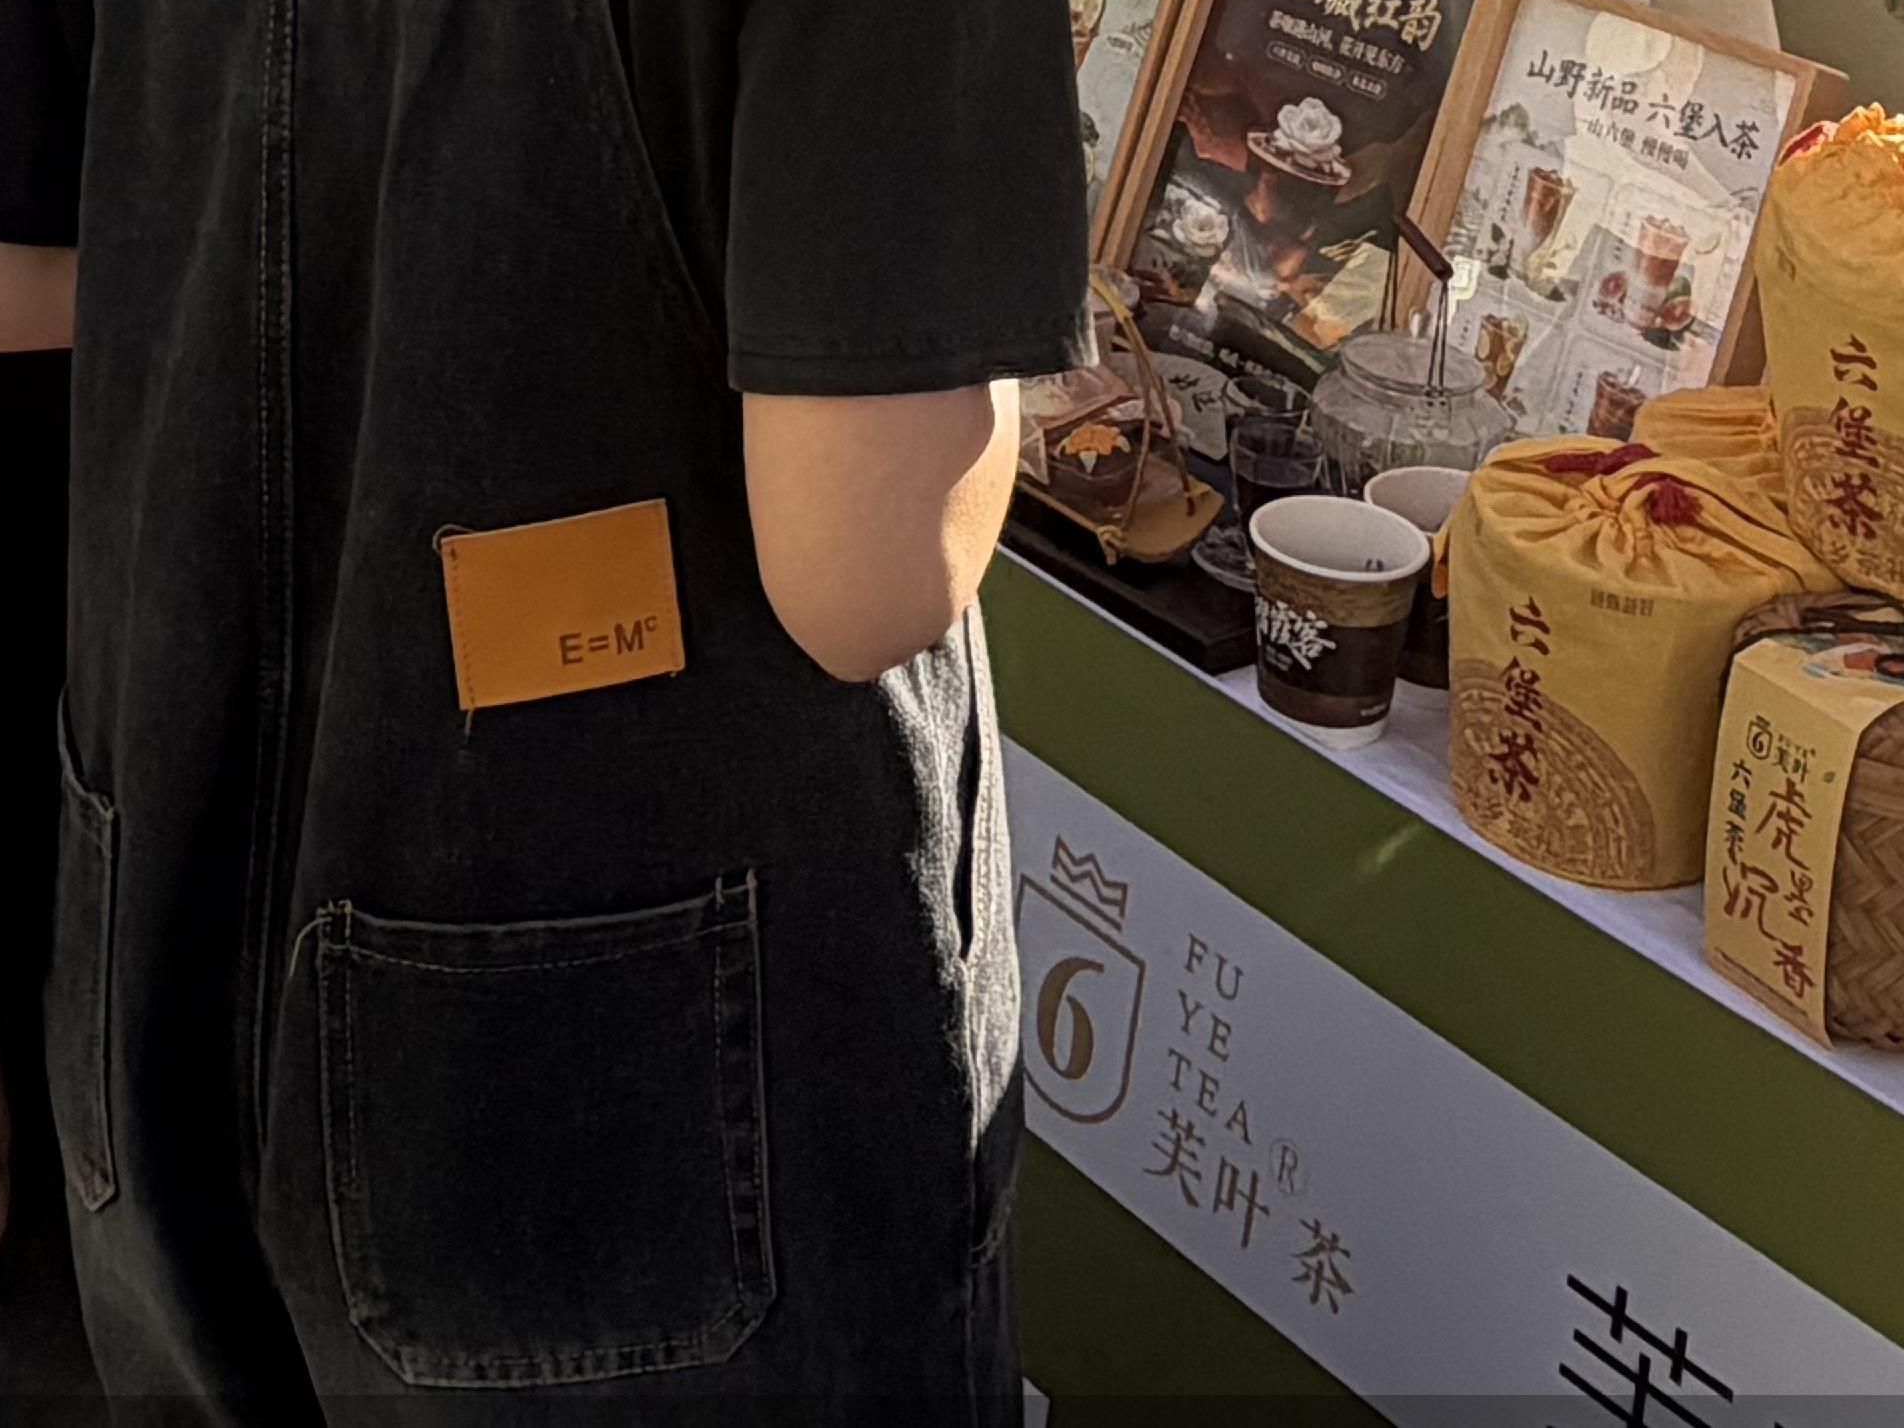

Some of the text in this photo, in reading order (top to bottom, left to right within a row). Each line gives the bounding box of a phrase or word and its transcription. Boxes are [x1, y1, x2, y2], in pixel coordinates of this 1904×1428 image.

[1527, 49, 1761, 161] 山野新品 六堡入茶
[1824, 333, 1885, 541] 六堡茶
[1487, 595, 1551, 804] 六堡茶
[1167, 1048, 1253, 1145] TEA
